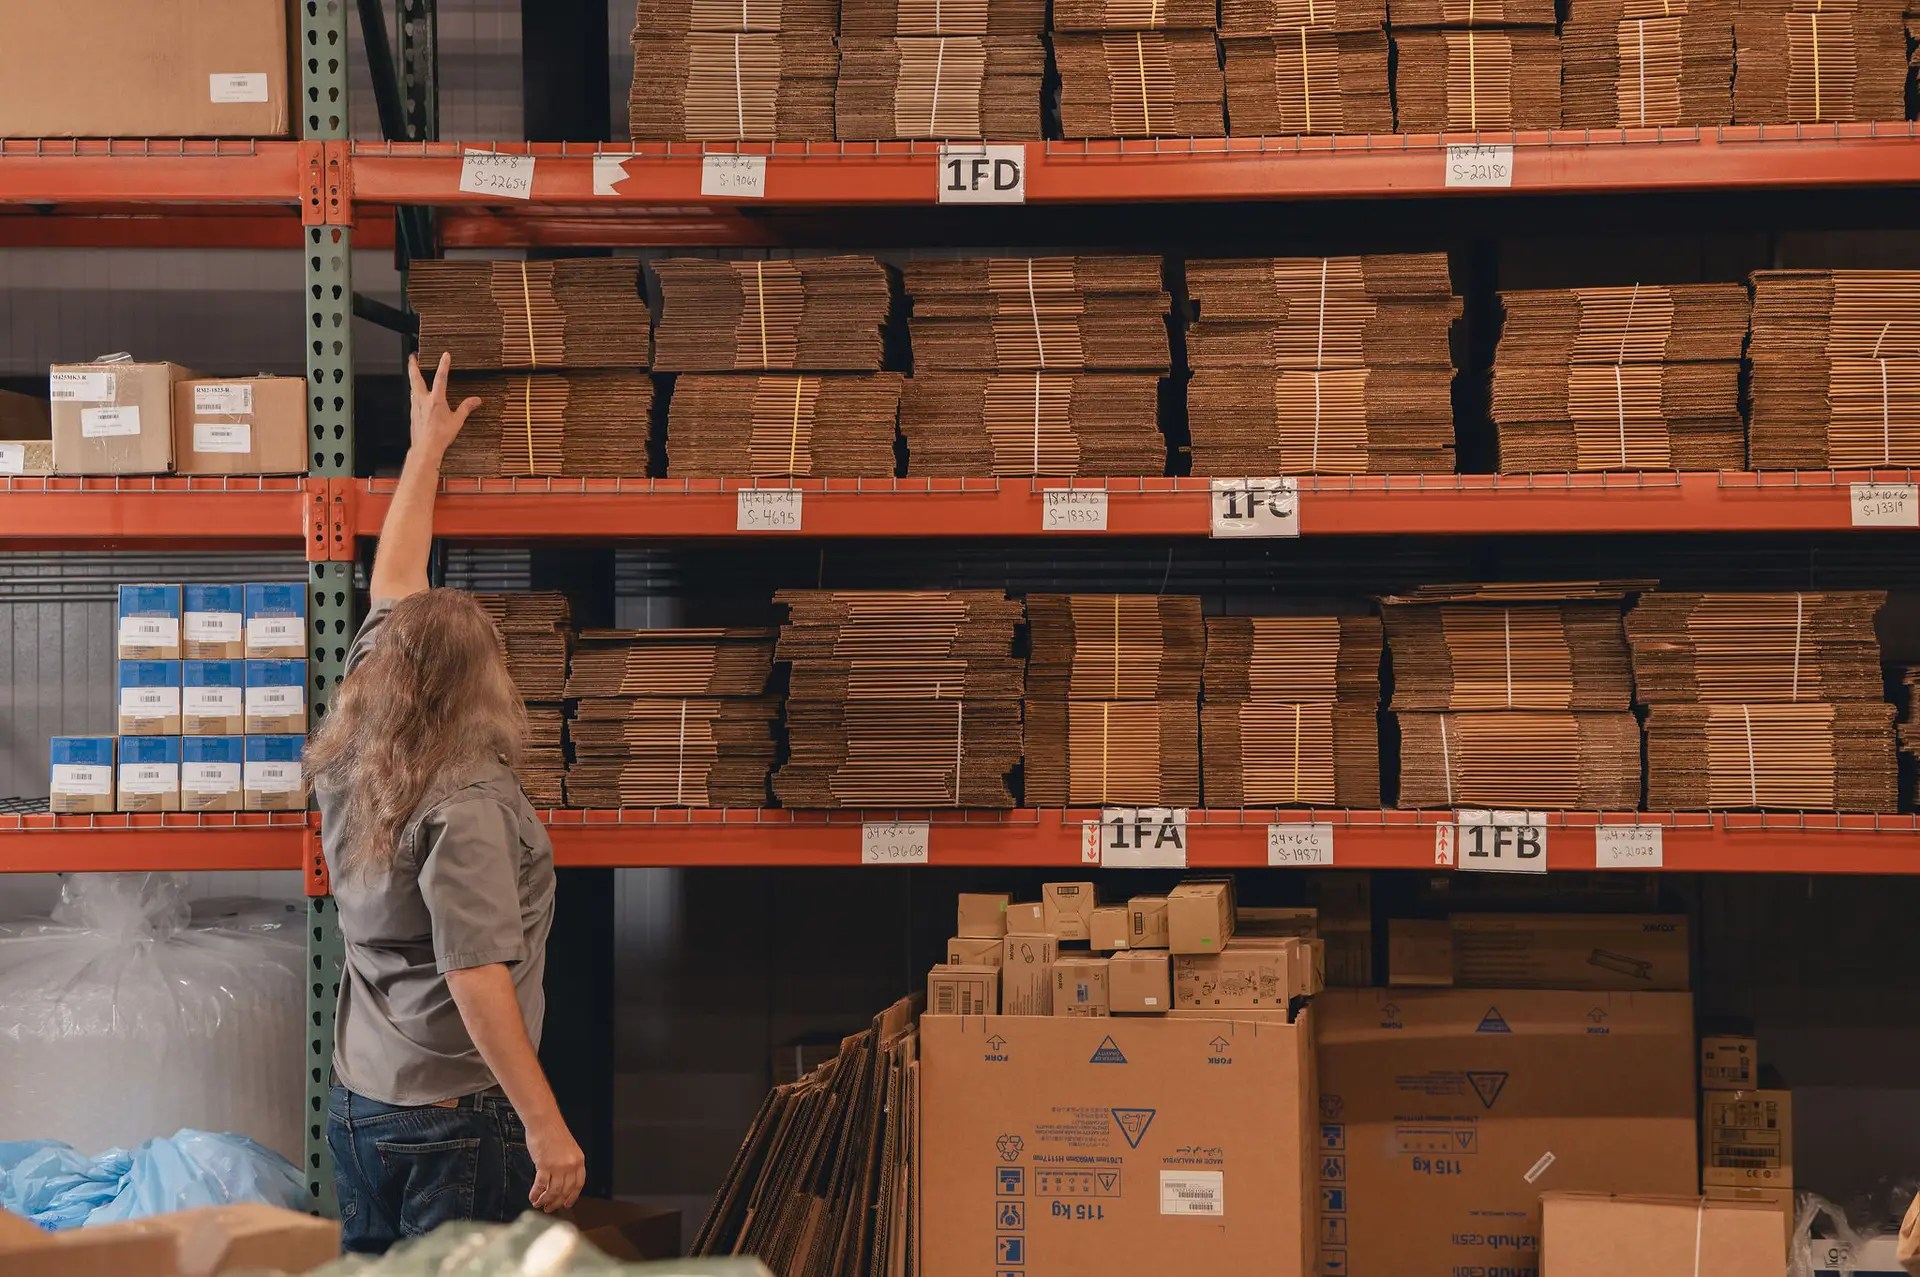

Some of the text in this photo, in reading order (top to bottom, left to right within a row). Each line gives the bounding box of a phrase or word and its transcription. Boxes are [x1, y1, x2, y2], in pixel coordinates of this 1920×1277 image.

[474, 170, 527, 190] S-22654
[948, 159, 1020, 191] 1FD
[1453, 164, 1508, 180] S-22180
[1223, 486, 1293, 519] 1FC
[1863, 501, 1904, 516] S-13319
[747, 509, 795, 526] S-4695
[1049, 508, 1100, 525] S-18352
[1110, 817, 1183, 849] 1FA
[1468, 826, 1541, 859] 1FB
[870, 845, 924, 861] S-12608
[1278, 848, 1322, 862] S-19871
[984, 1054, 1009, 1062] FORK
[1208, 1056, 1232, 1064] FORK
[1413, 1157, 1462, 1175] 115 kg
[1052, 1200, 1104, 1220] 115 kg
